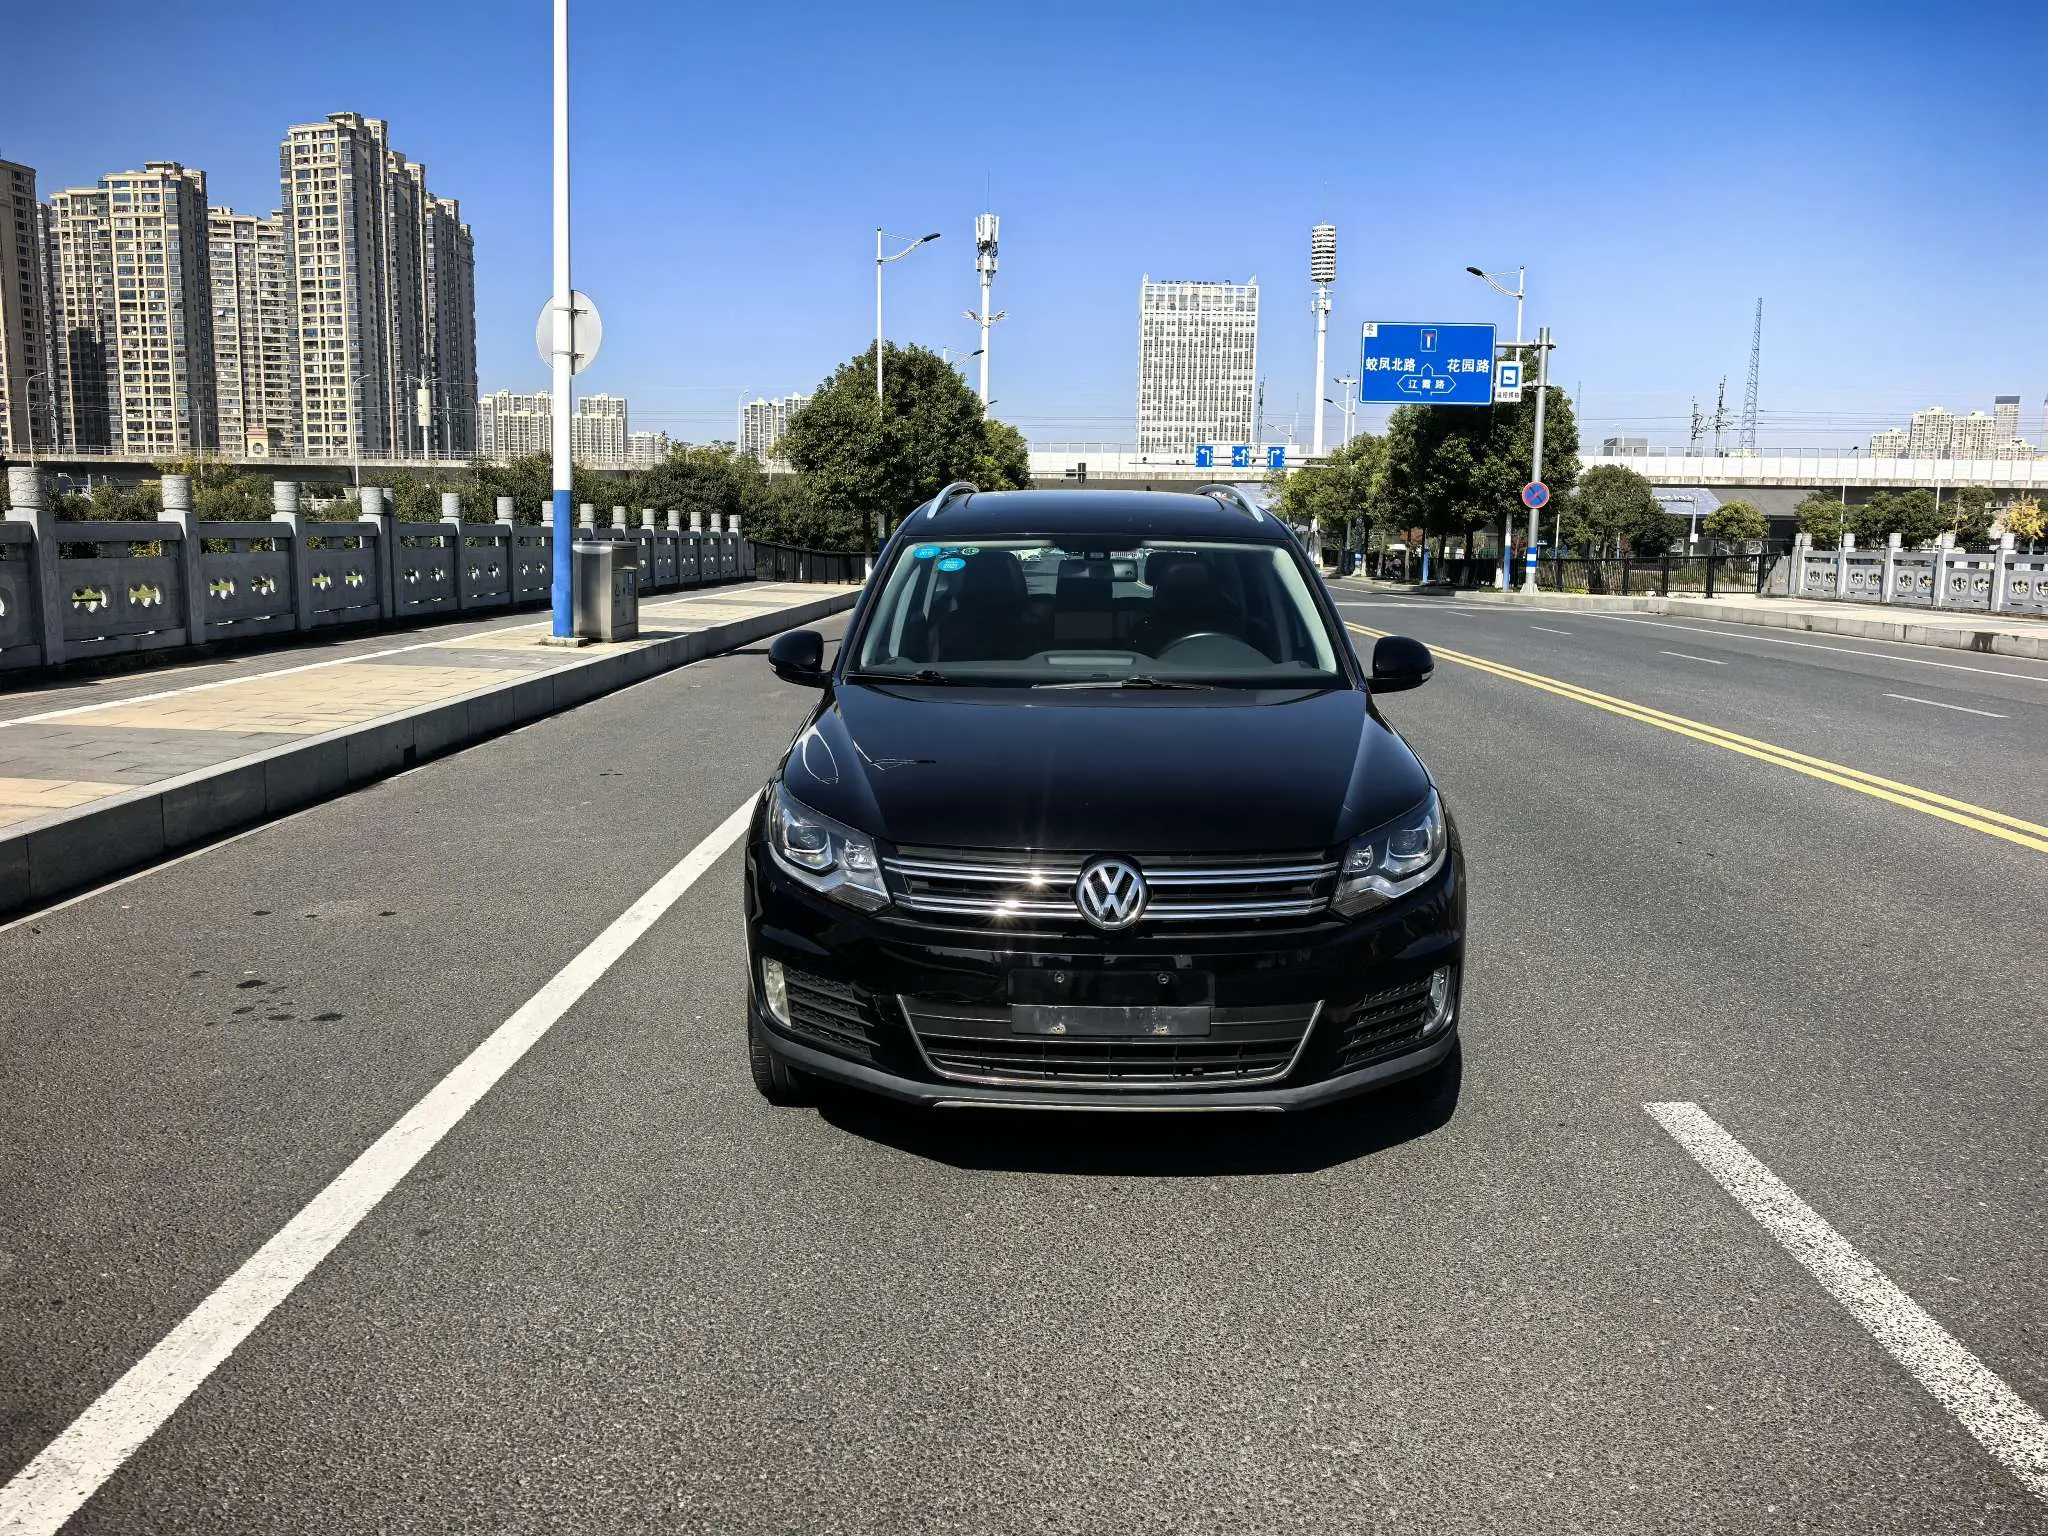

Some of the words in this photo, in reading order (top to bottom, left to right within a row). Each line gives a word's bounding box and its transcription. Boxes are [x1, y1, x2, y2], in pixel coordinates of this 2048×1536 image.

[1365, 357, 1416, 372] 蛟凤北路
[1447, 358, 1490, 373] 花园路
